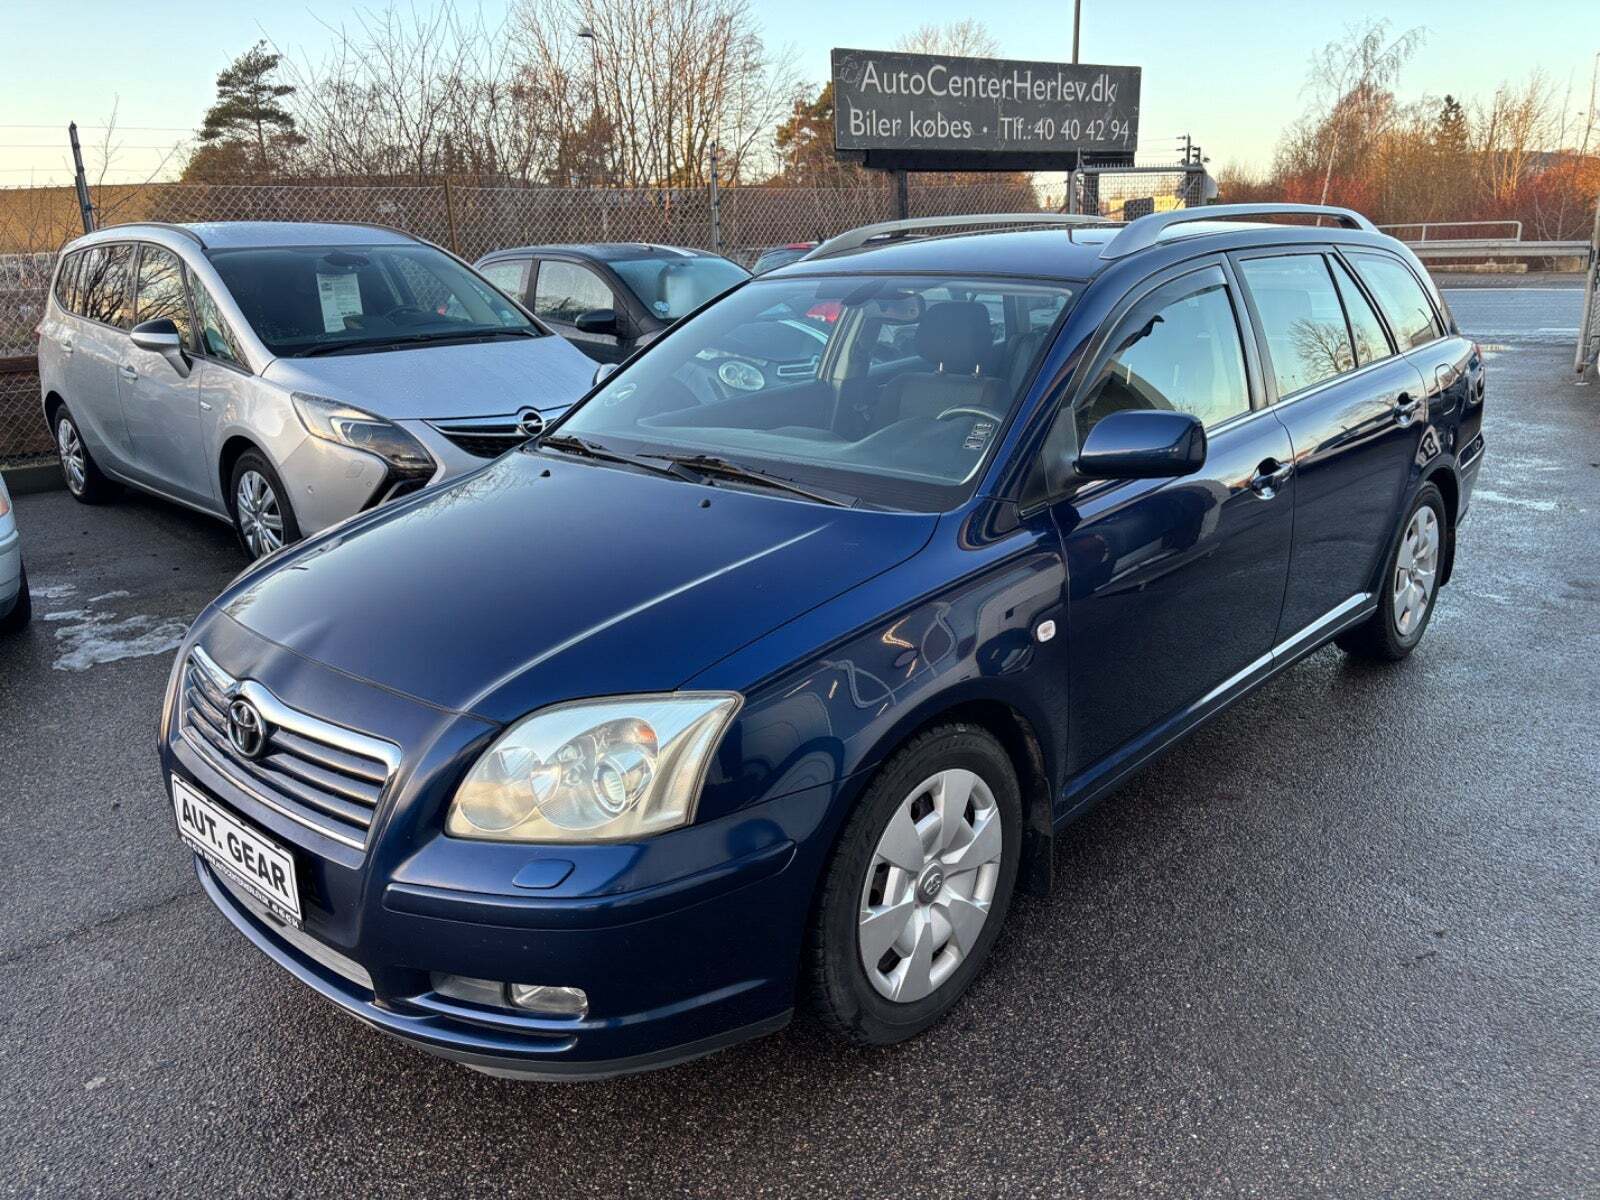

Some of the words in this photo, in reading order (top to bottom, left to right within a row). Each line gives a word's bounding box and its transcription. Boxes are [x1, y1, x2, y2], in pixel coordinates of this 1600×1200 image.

[860, 60, 1118, 102] AutoCenterHerlev.dk
[849, 107, 902, 137] Biler
[909, 110, 973, 139] købes
[1060, 119, 1080, 141] 40
[1085, 119, 1105, 141] 42
[1110, 119, 1129, 142] 94
[182, 798, 223, 850] AUT.
[226, 831, 290, 898] GEAR
